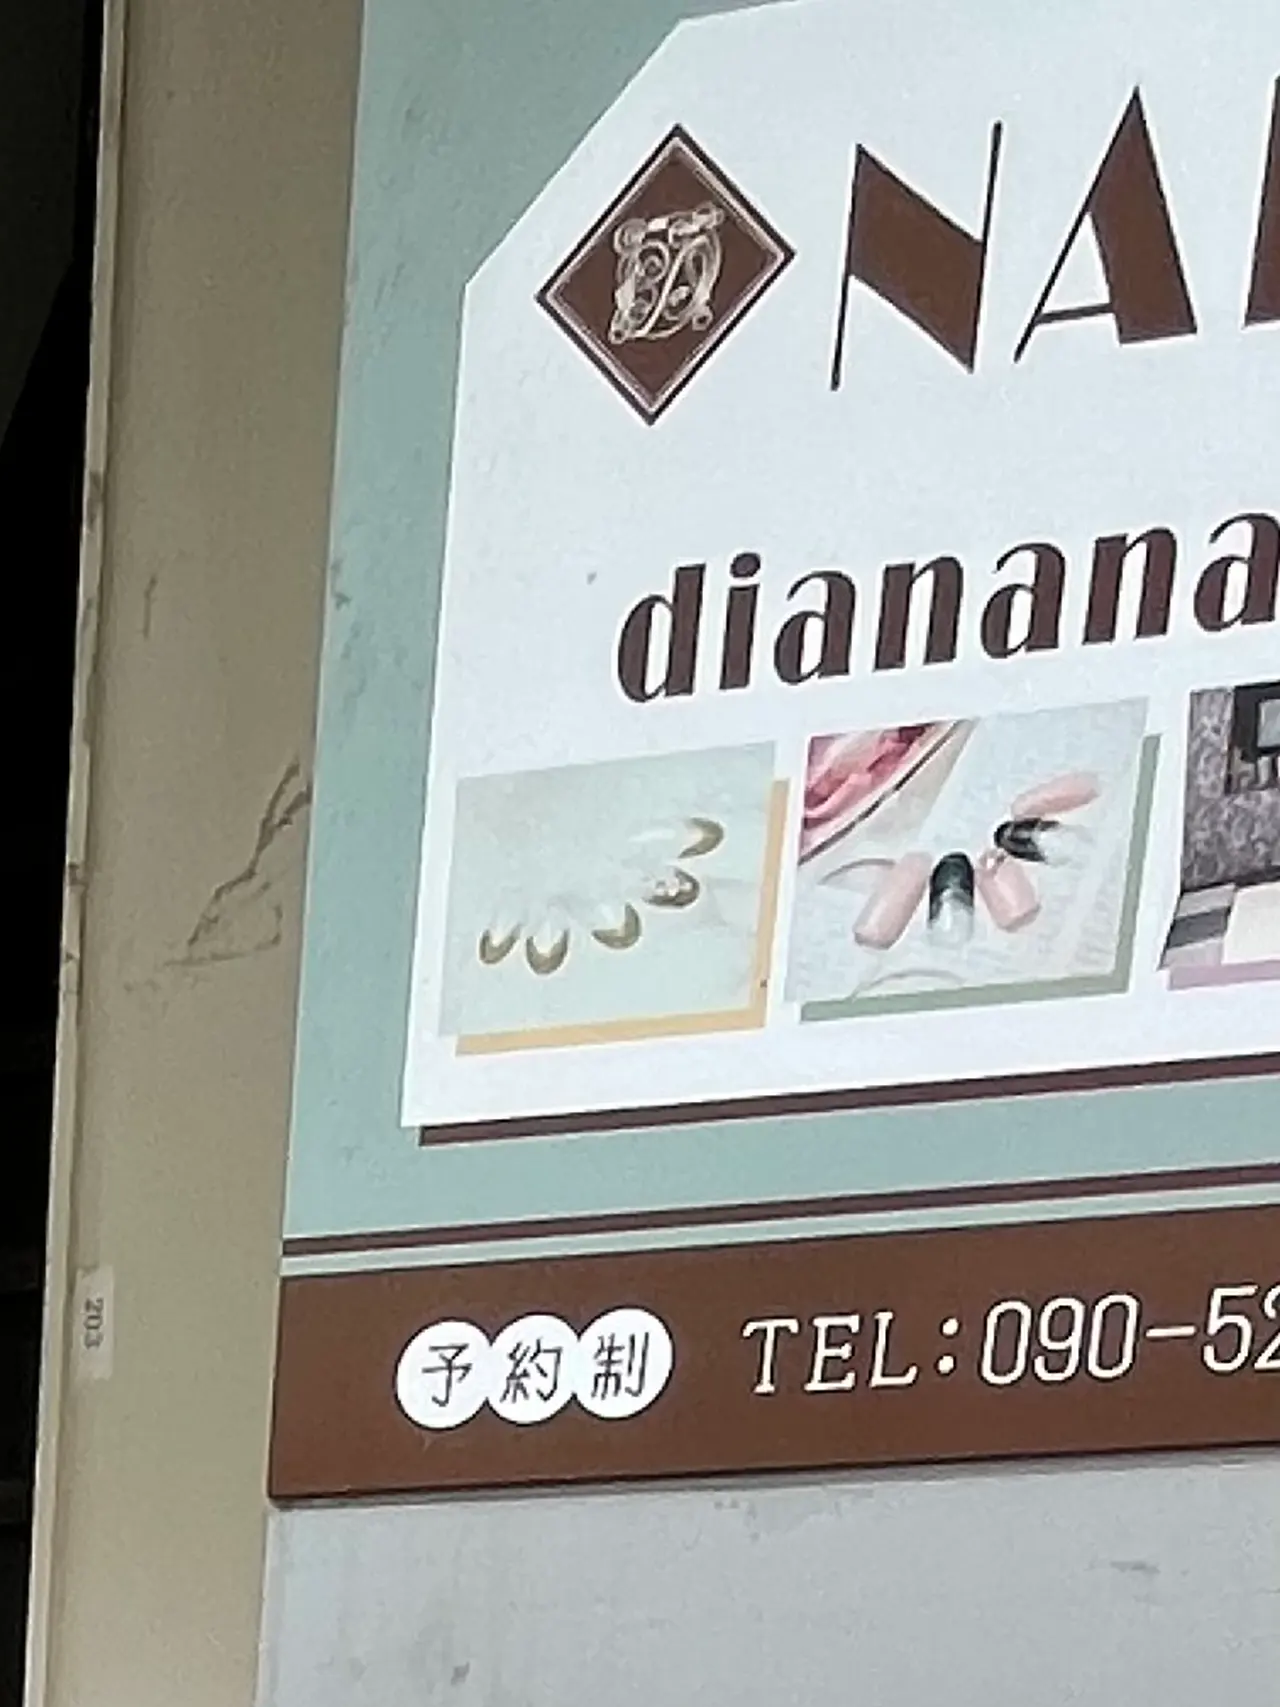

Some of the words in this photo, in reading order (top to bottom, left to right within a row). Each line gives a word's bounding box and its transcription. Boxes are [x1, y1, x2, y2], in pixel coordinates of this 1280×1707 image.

[82, 1297, 105, 1351] 203
[420, 1332, 650, 1409] 予約制
